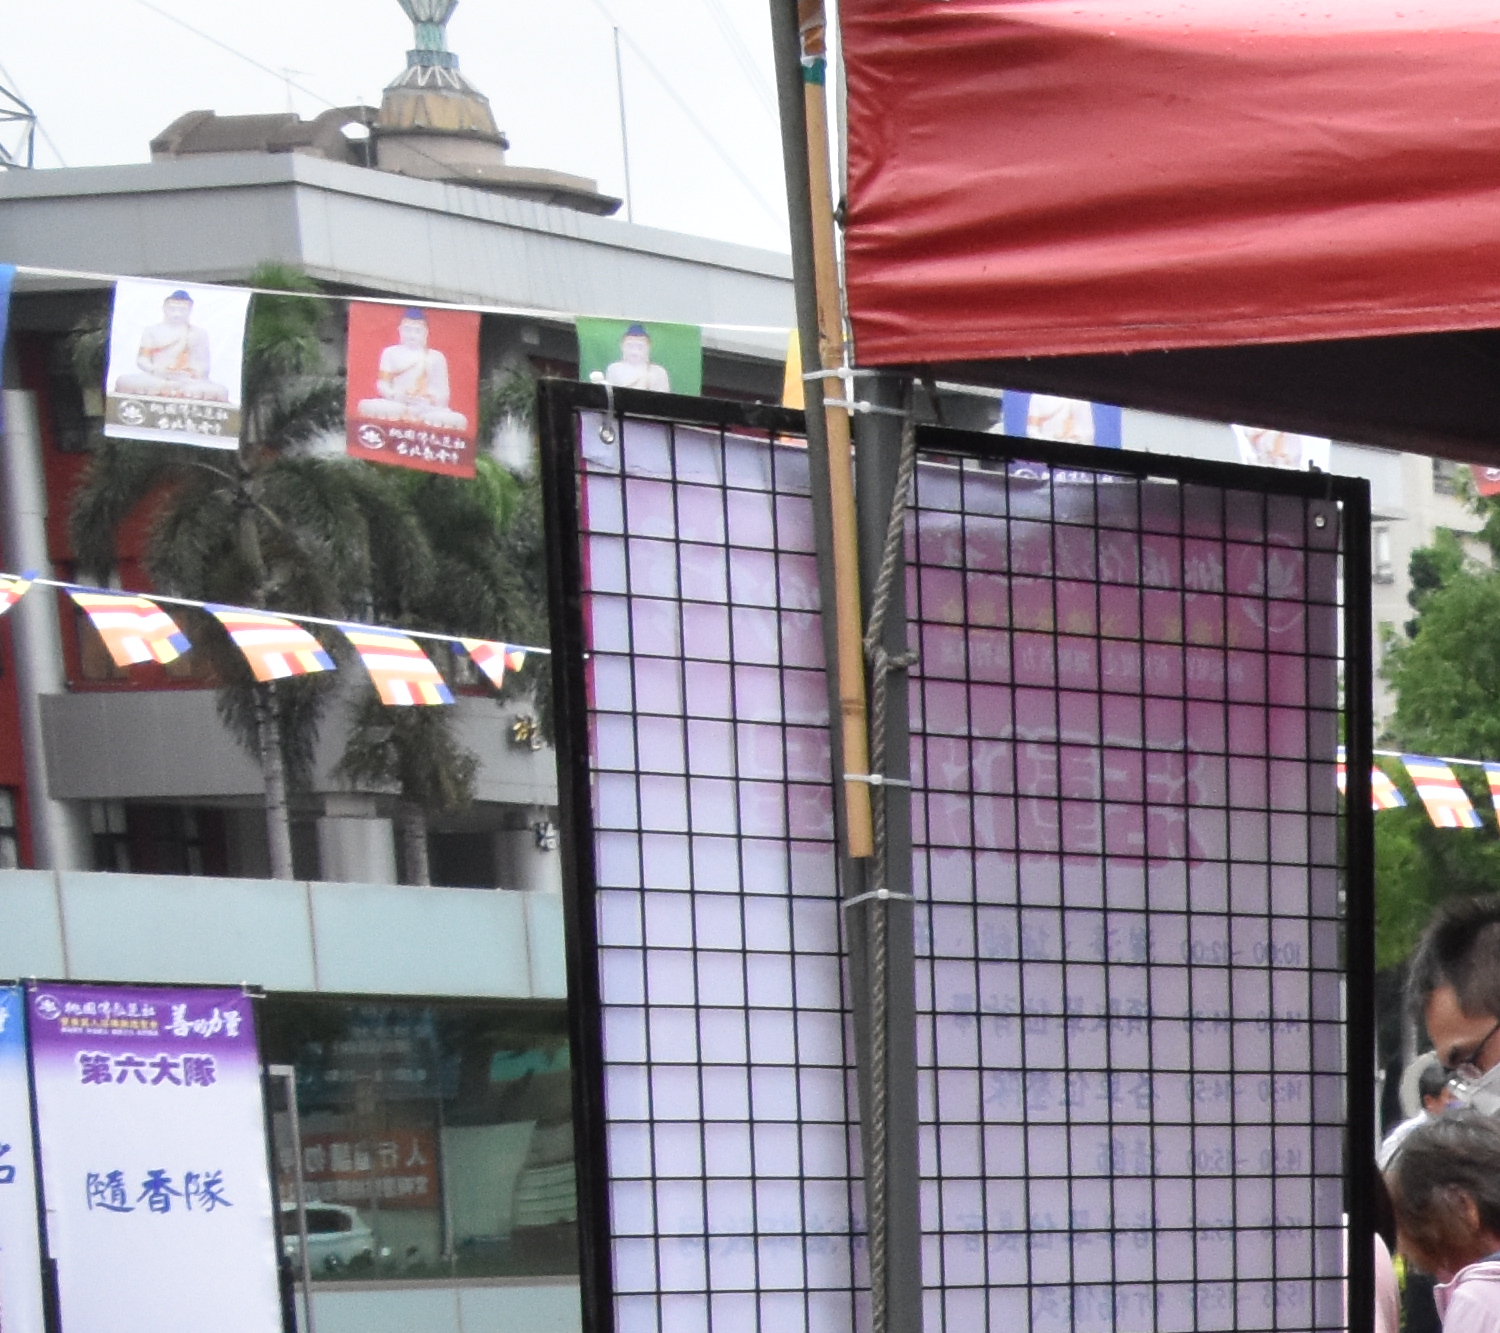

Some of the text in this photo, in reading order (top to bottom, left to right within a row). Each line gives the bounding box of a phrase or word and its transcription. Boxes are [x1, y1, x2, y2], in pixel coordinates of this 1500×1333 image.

[78, 1053, 217, 1087] 第六大隊
[86, 1169, 234, 1214] 隨香隊
